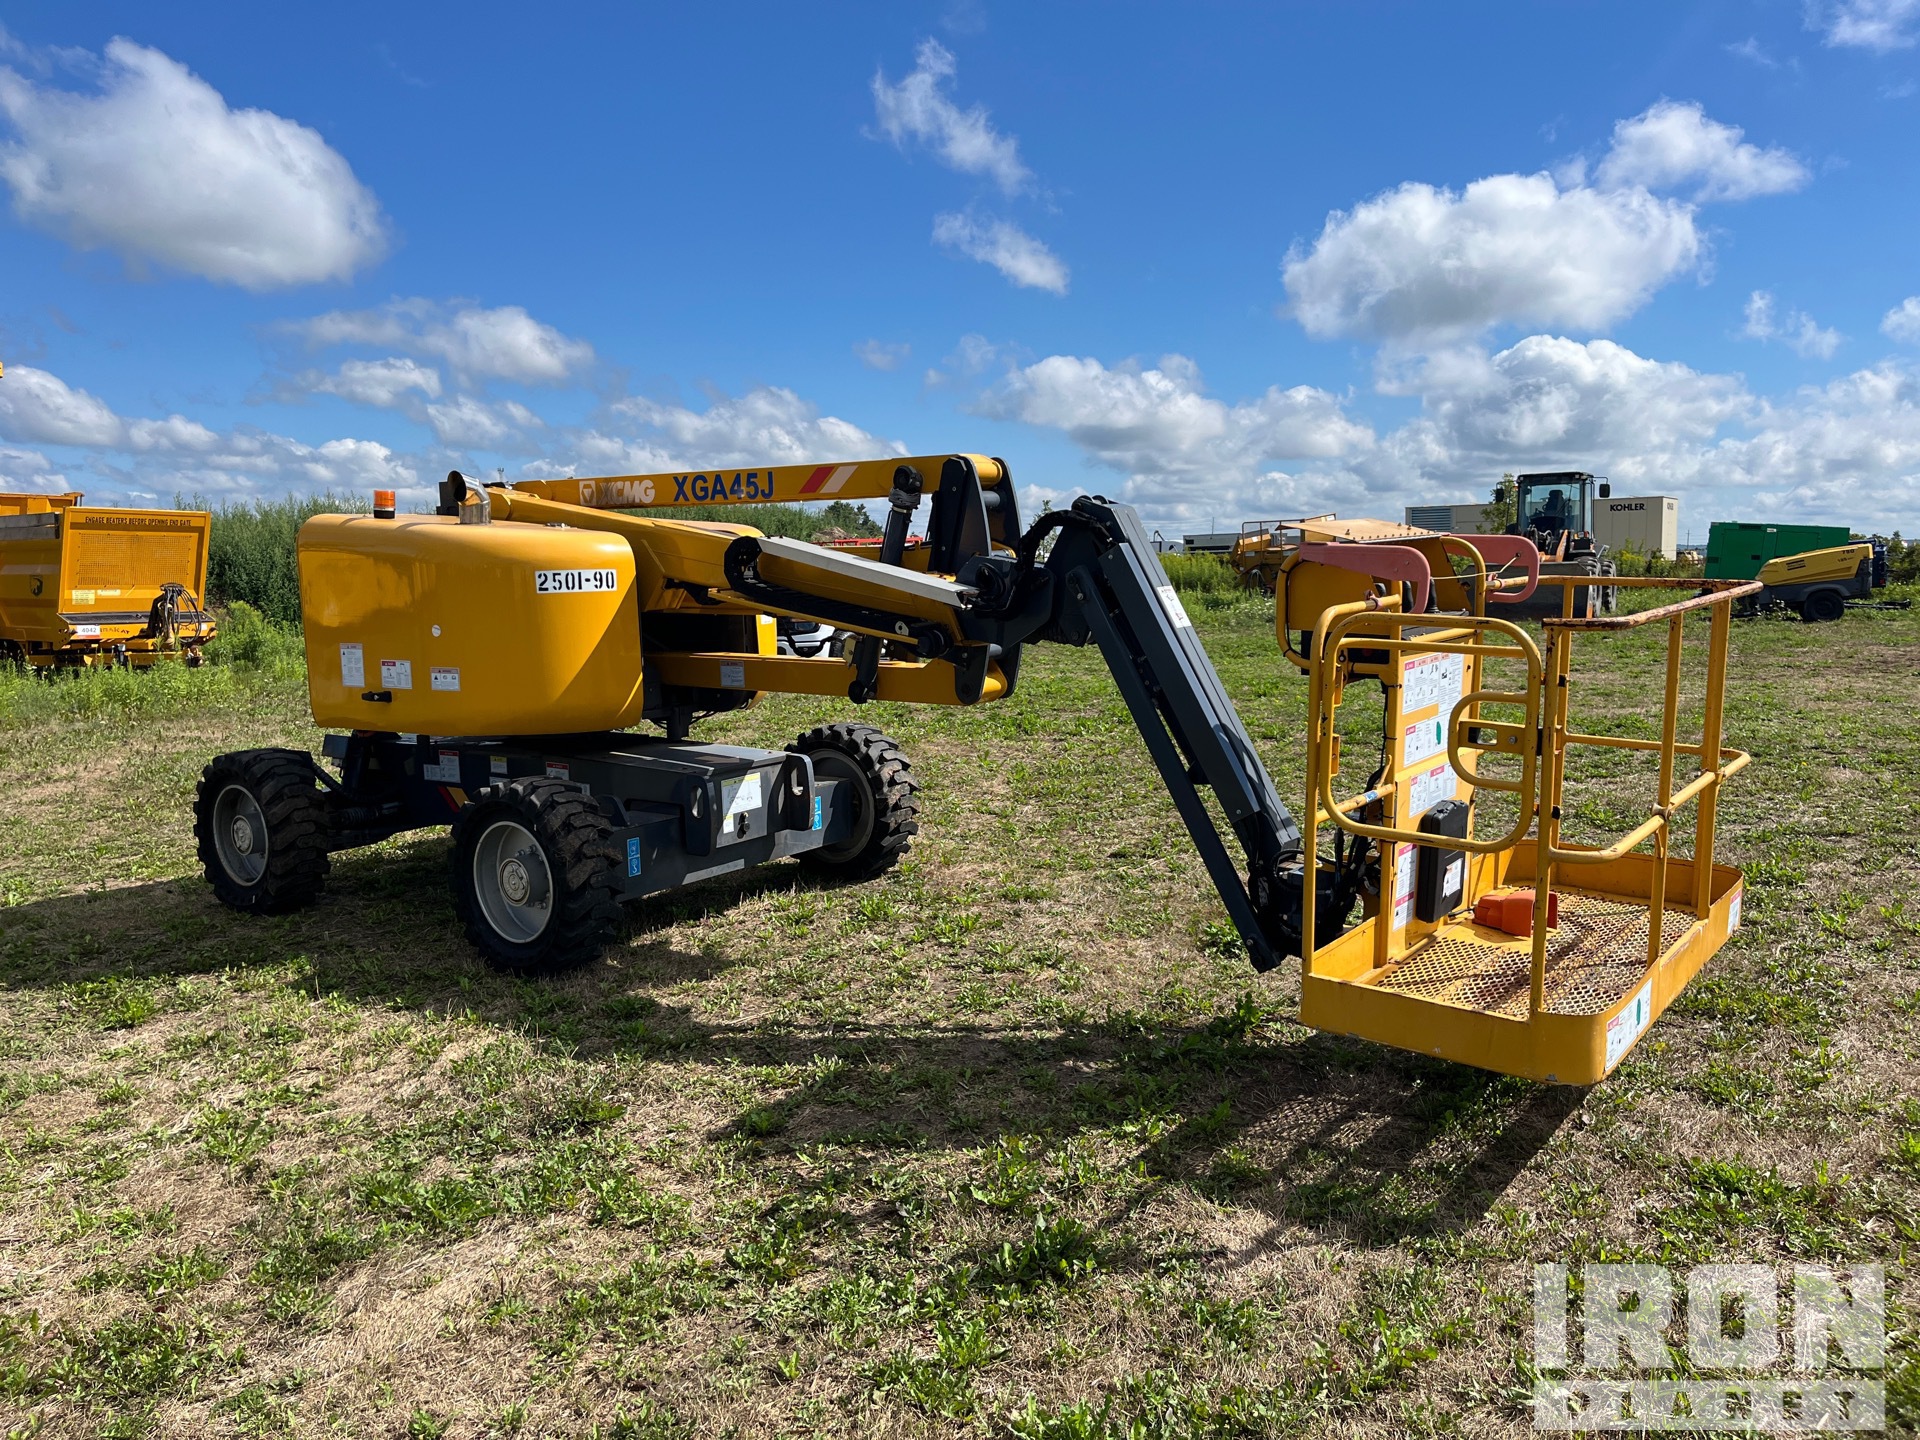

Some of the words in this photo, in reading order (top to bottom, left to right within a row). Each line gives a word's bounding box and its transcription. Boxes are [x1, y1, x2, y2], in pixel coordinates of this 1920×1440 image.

[599, 479, 655, 505] XCMG
[673, 471, 774, 502] XGA45J
[1610, 503, 1645, 511] KOHLER
[537, 571, 615, 592] 2501-90
